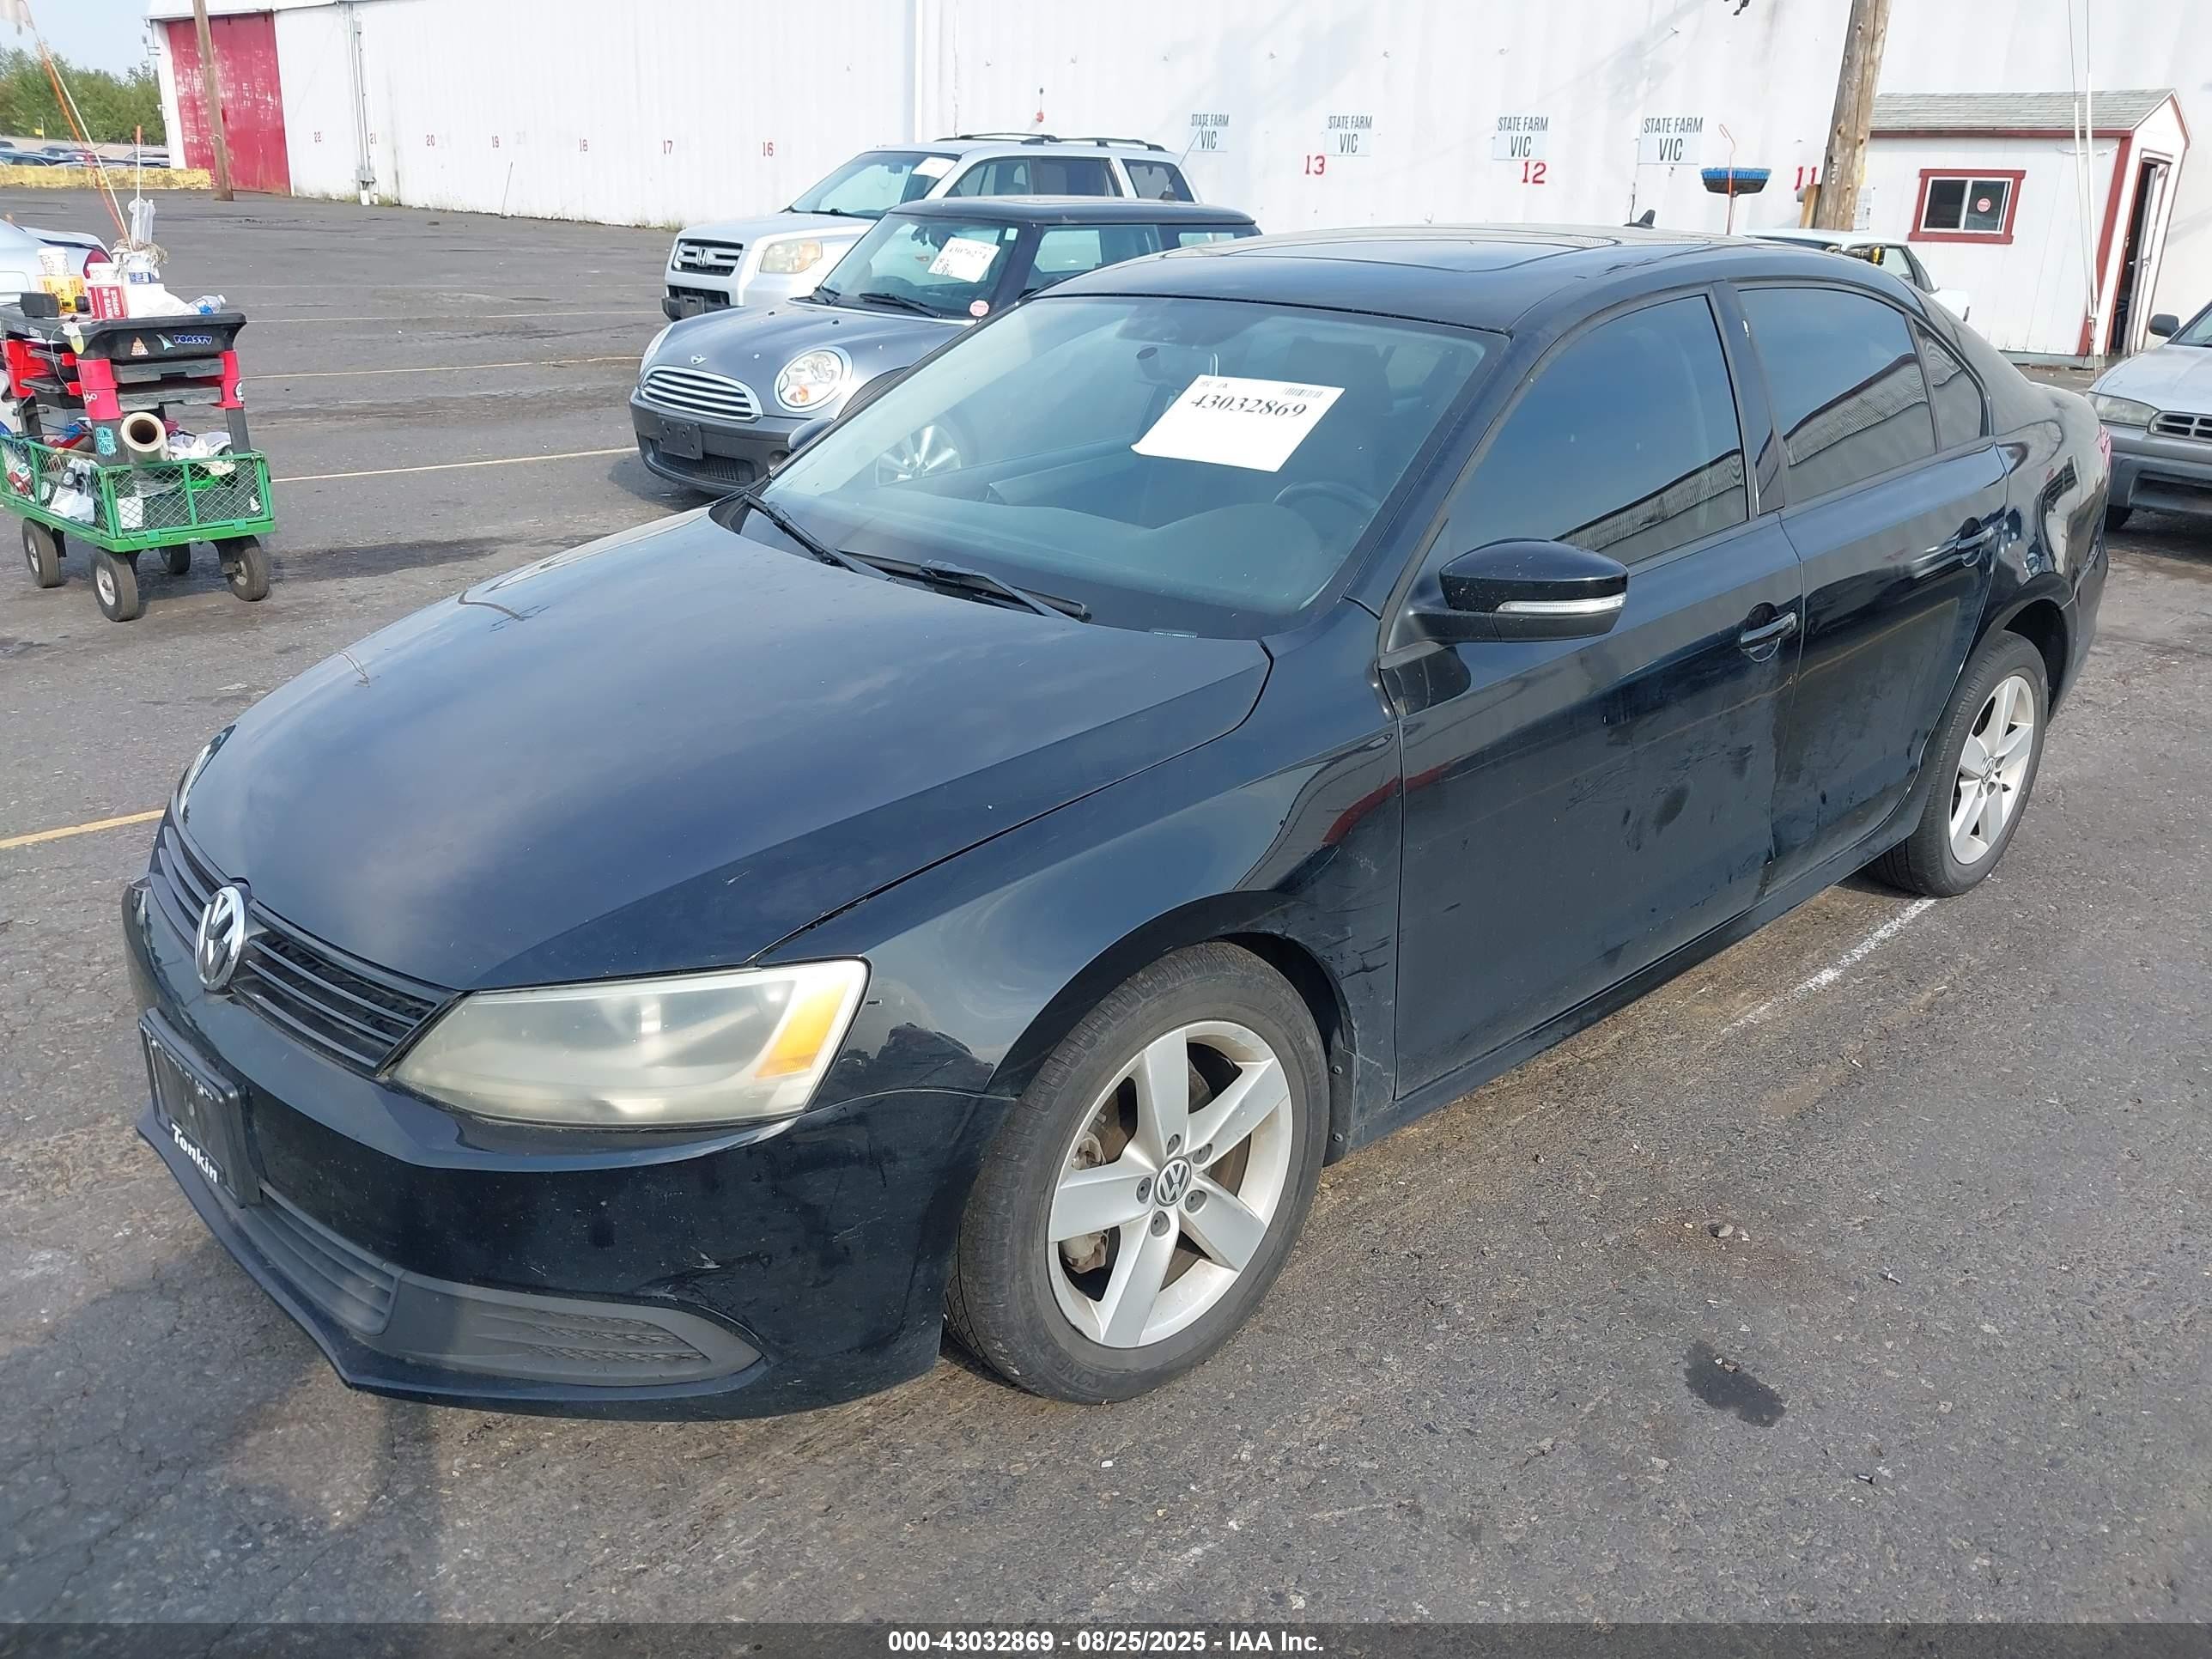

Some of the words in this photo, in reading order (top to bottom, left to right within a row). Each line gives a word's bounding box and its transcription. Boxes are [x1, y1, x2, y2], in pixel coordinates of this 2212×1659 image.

[1191, 113, 1209, 127] STATE
[1210, 113, 1229, 128] FARM
[1328, 115, 1348, 130] STATE
[1351, 115, 1372, 130] FARM
[1498, 116, 1521, 131] STATE
[1523, 116, 1549, 131] FARM
[1644, 117, 1673, 134] STATE
[1674, 117, 1704, 134] FARM
[313, 131, 322, 143] 22
[369, 132, 377, 144] 21
[426, 134, 435, 147] 20
[491, 136, 500, 149] 19
[579, 138, 588, 152] 18
[1200, 131, 1217, 149] VIC
[1340, 133, 1358, 154] VIC
[663, 140, 673, 155] 17
[763, 142, 774, 156] 16
[1510, 135, 1532, 158] VIC
[1659, 137, 1683, 161] VIC
[1304, 155, 1326, 175] 13
[1522, 161, 1547, 184] 12
[1794, 166, 1817, 191] 11
[110, 289, 121, 316] OFFICE
[173, 334, 213, 345] TOASTY
[1190, 393, 1307, 418] 43032869
[172, 1123, 218, 1184] Tonkin
